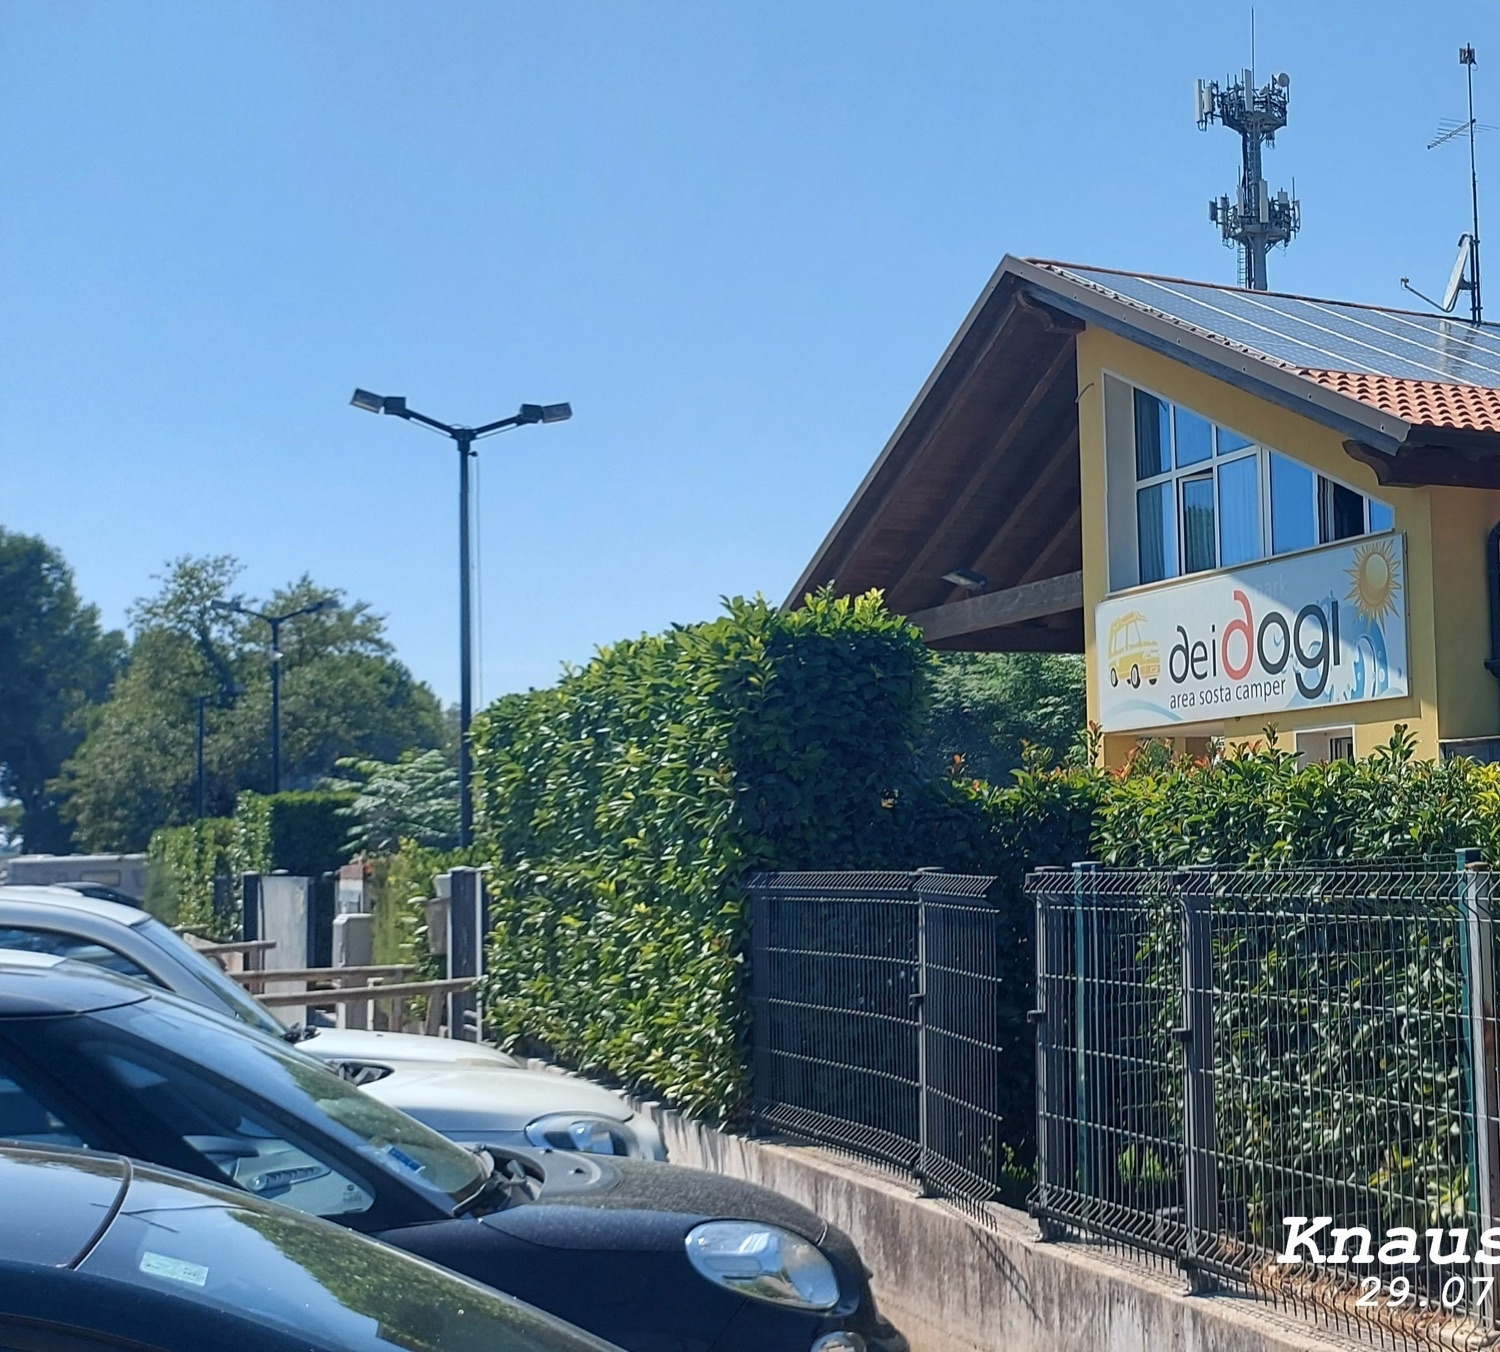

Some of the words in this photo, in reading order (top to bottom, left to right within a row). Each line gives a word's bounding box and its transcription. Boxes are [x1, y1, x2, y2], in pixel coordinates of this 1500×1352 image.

[1170, 692, 1196, 709] area
[1199, 685, 1232, 705] sosta
[1235, 679, 1286, 702] camper
